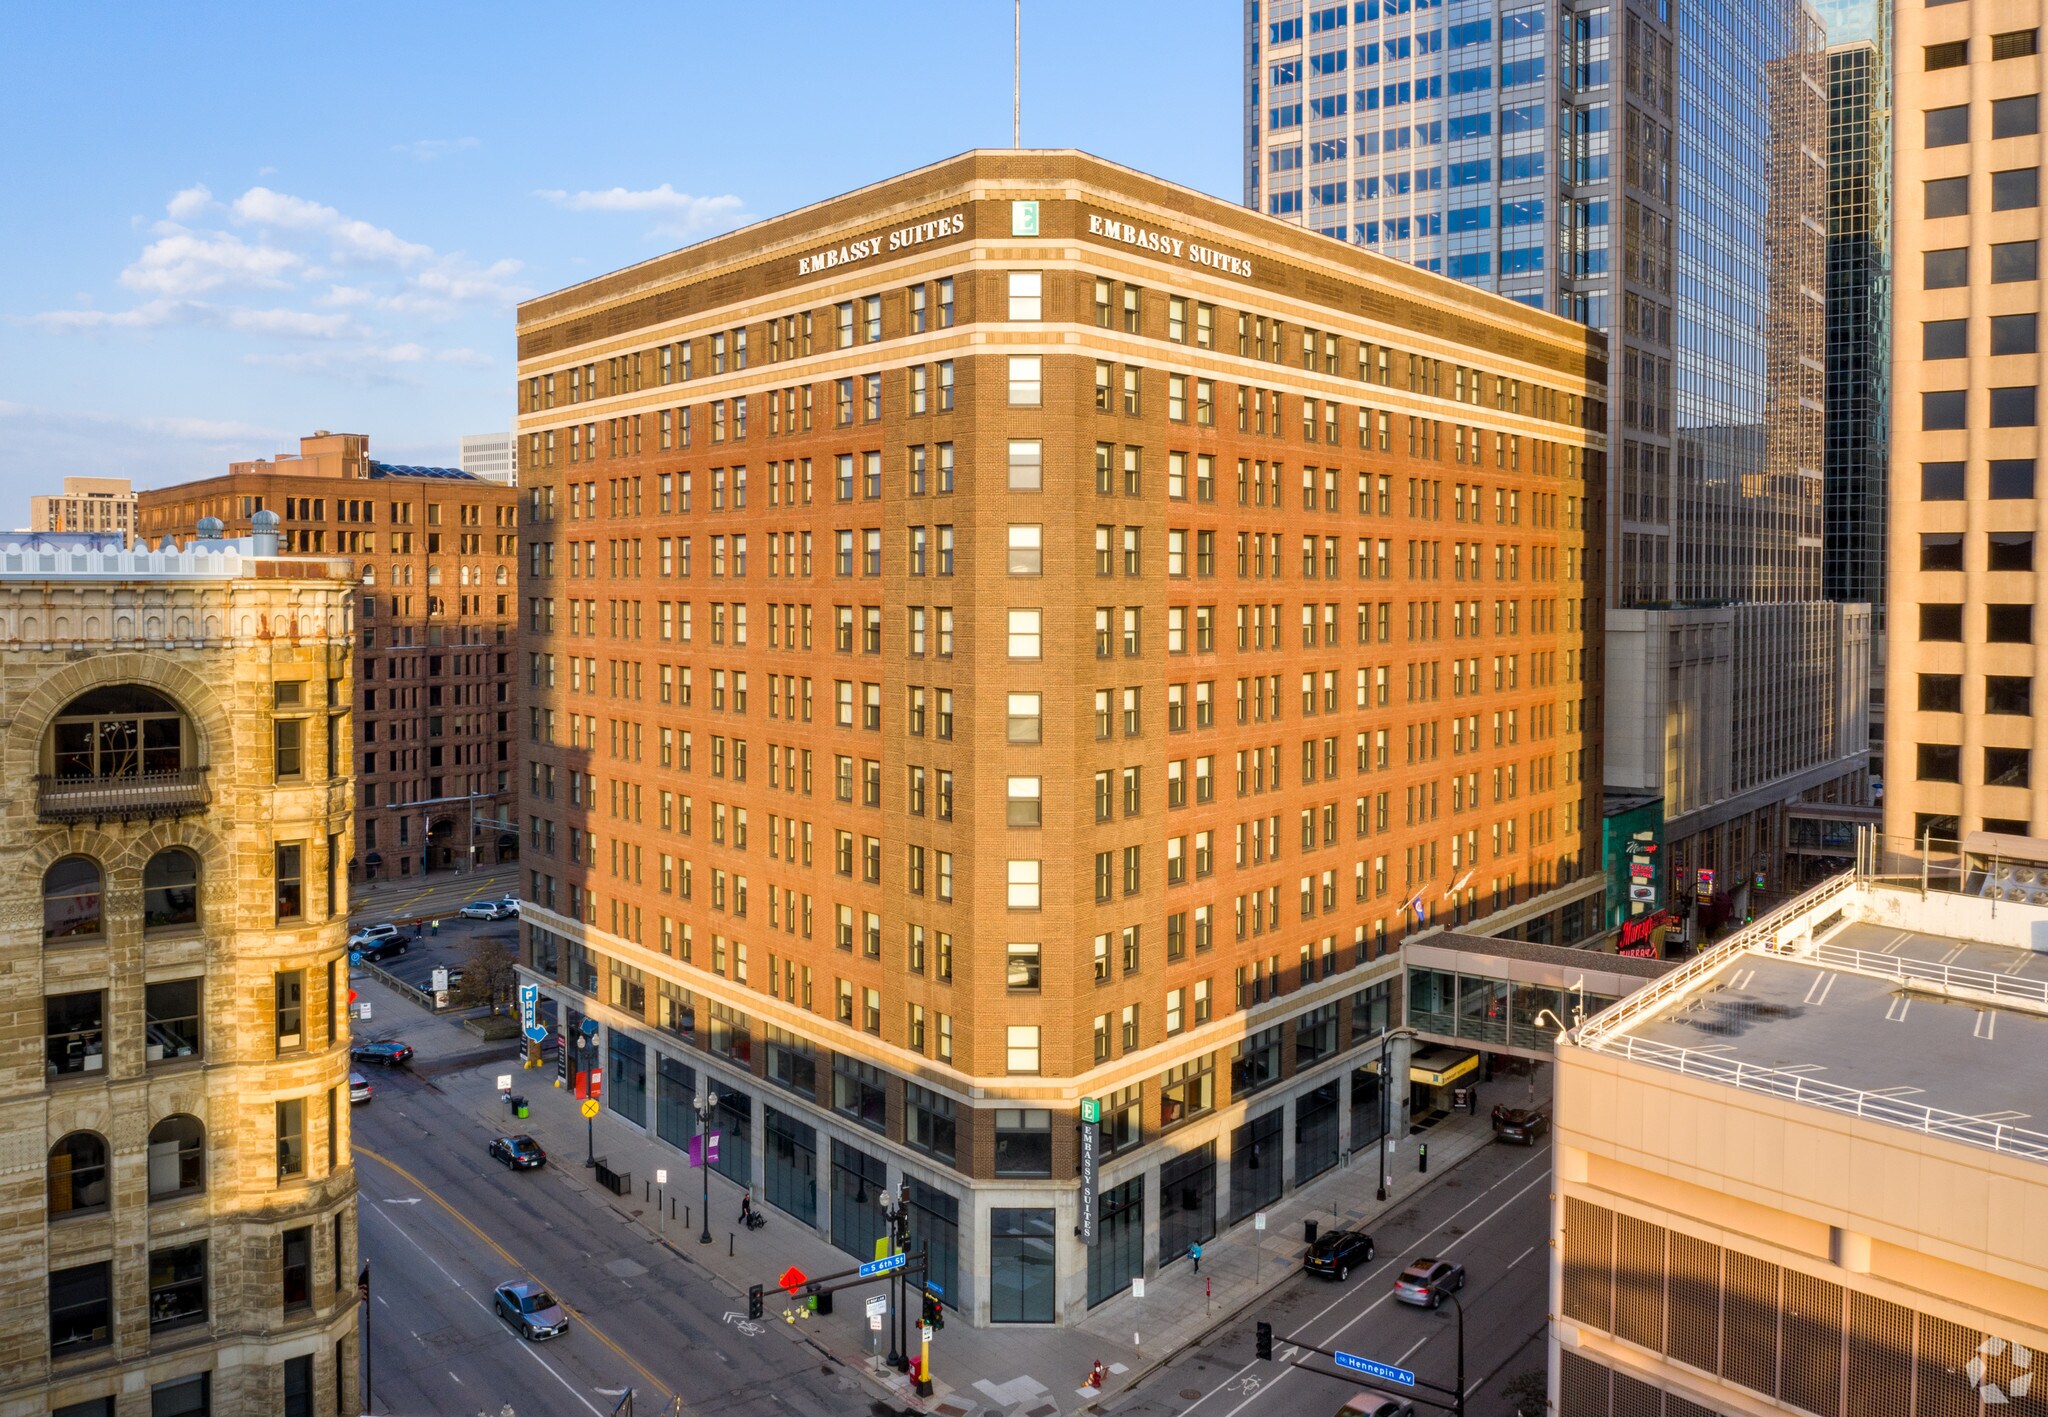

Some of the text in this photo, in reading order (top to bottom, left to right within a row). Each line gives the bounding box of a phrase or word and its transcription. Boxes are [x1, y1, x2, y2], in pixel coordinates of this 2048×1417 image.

[798, 213, 965, 276] EMBASSY SUITES
[1088, 213, 1252, 279] EMBASSY SUITES
[525, 990, 533, 1029] PARK
[1083, 1126, 1092, 1237] EMBASSY SUITES
[879, 1260, 893, 1269] 6th
[895, 1257, 904, 1265] St
[1348, 1358, 1412, 1382] Hennepin Av
